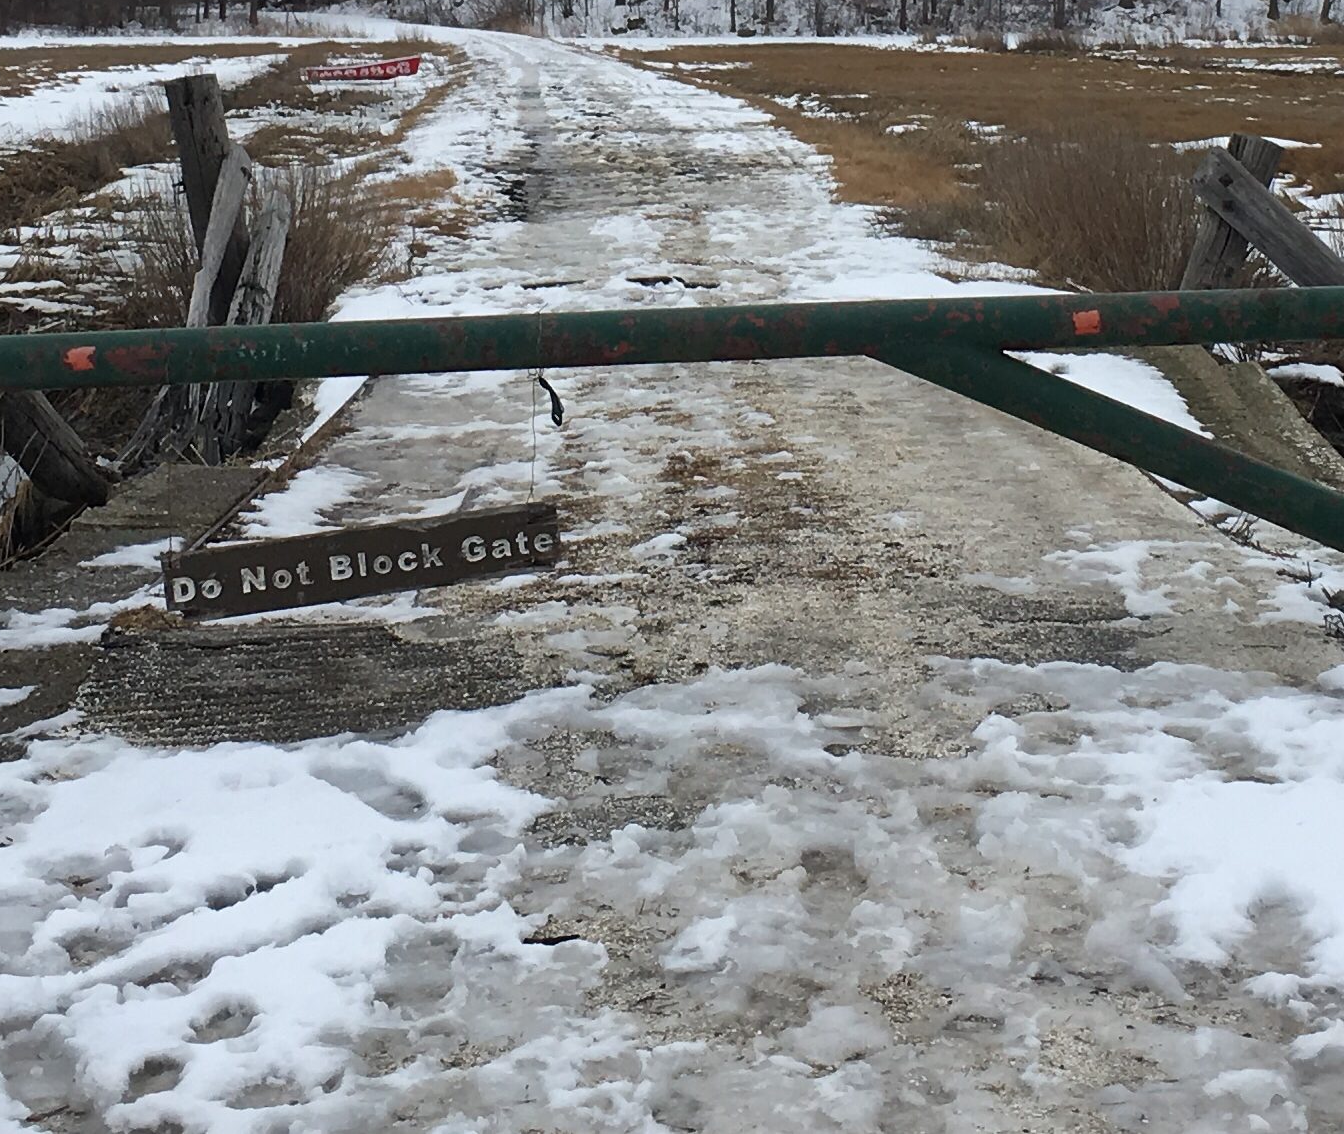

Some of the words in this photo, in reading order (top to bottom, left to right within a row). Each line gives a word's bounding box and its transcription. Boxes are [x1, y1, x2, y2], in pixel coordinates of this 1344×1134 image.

[171, 576, 223, 604] Do
[240, 561, 314, 594] Not
[328, 543, 443, 582] Block
[460, 530, 554, 563] Gate
